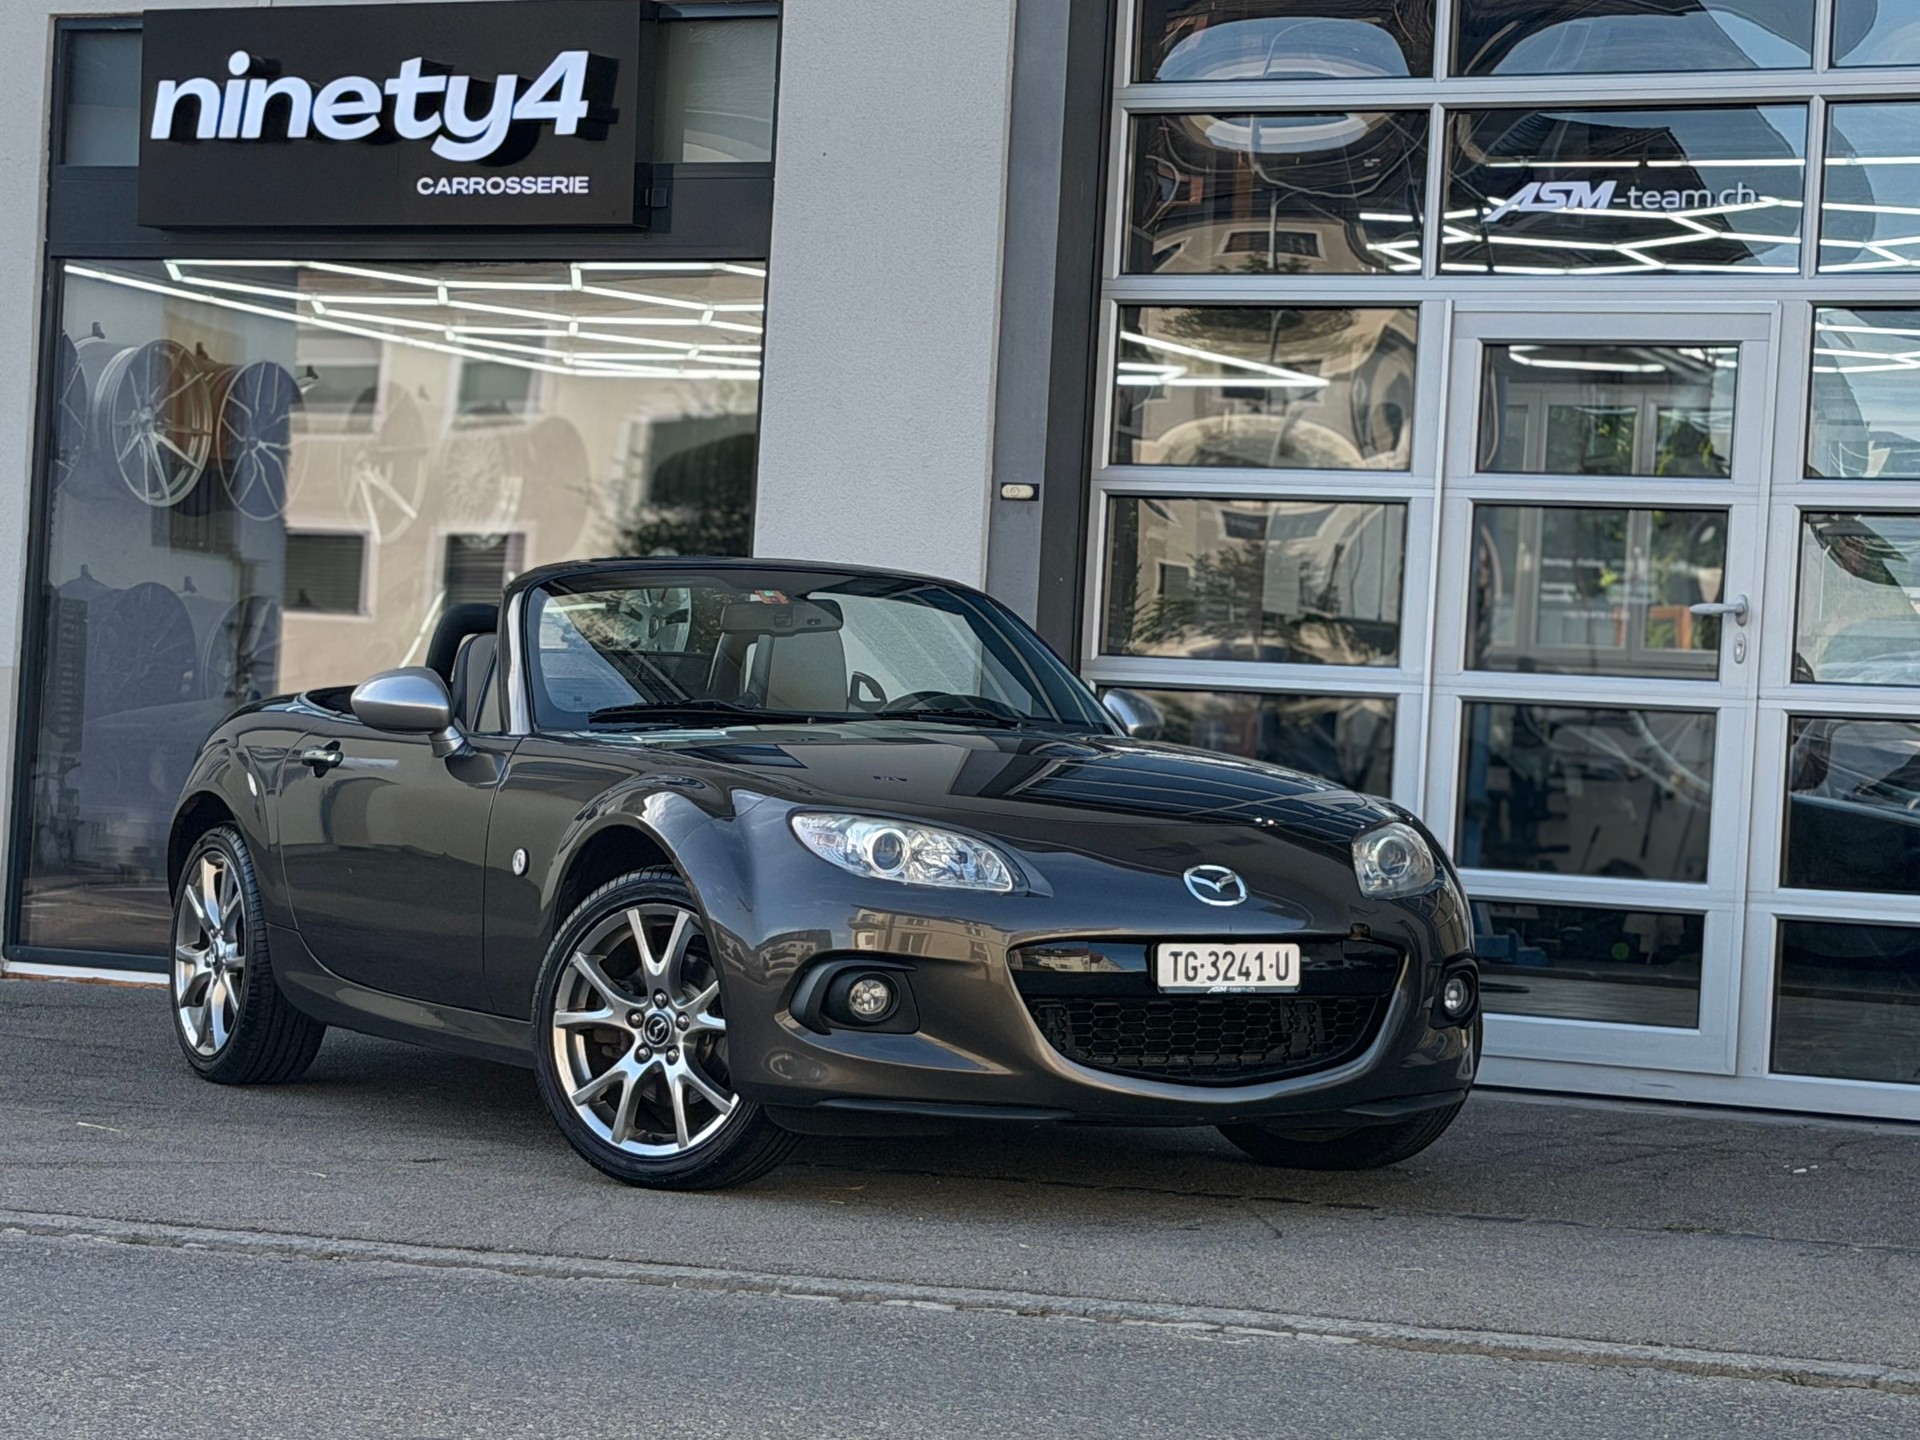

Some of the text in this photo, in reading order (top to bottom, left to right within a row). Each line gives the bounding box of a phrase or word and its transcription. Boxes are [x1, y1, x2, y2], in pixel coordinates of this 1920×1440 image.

[150, 50, 589, 162] ninety4
[416, 175, 589, 195] CARROSSERIE
[1482, 180, 1756, 222] ASM-team.ch
